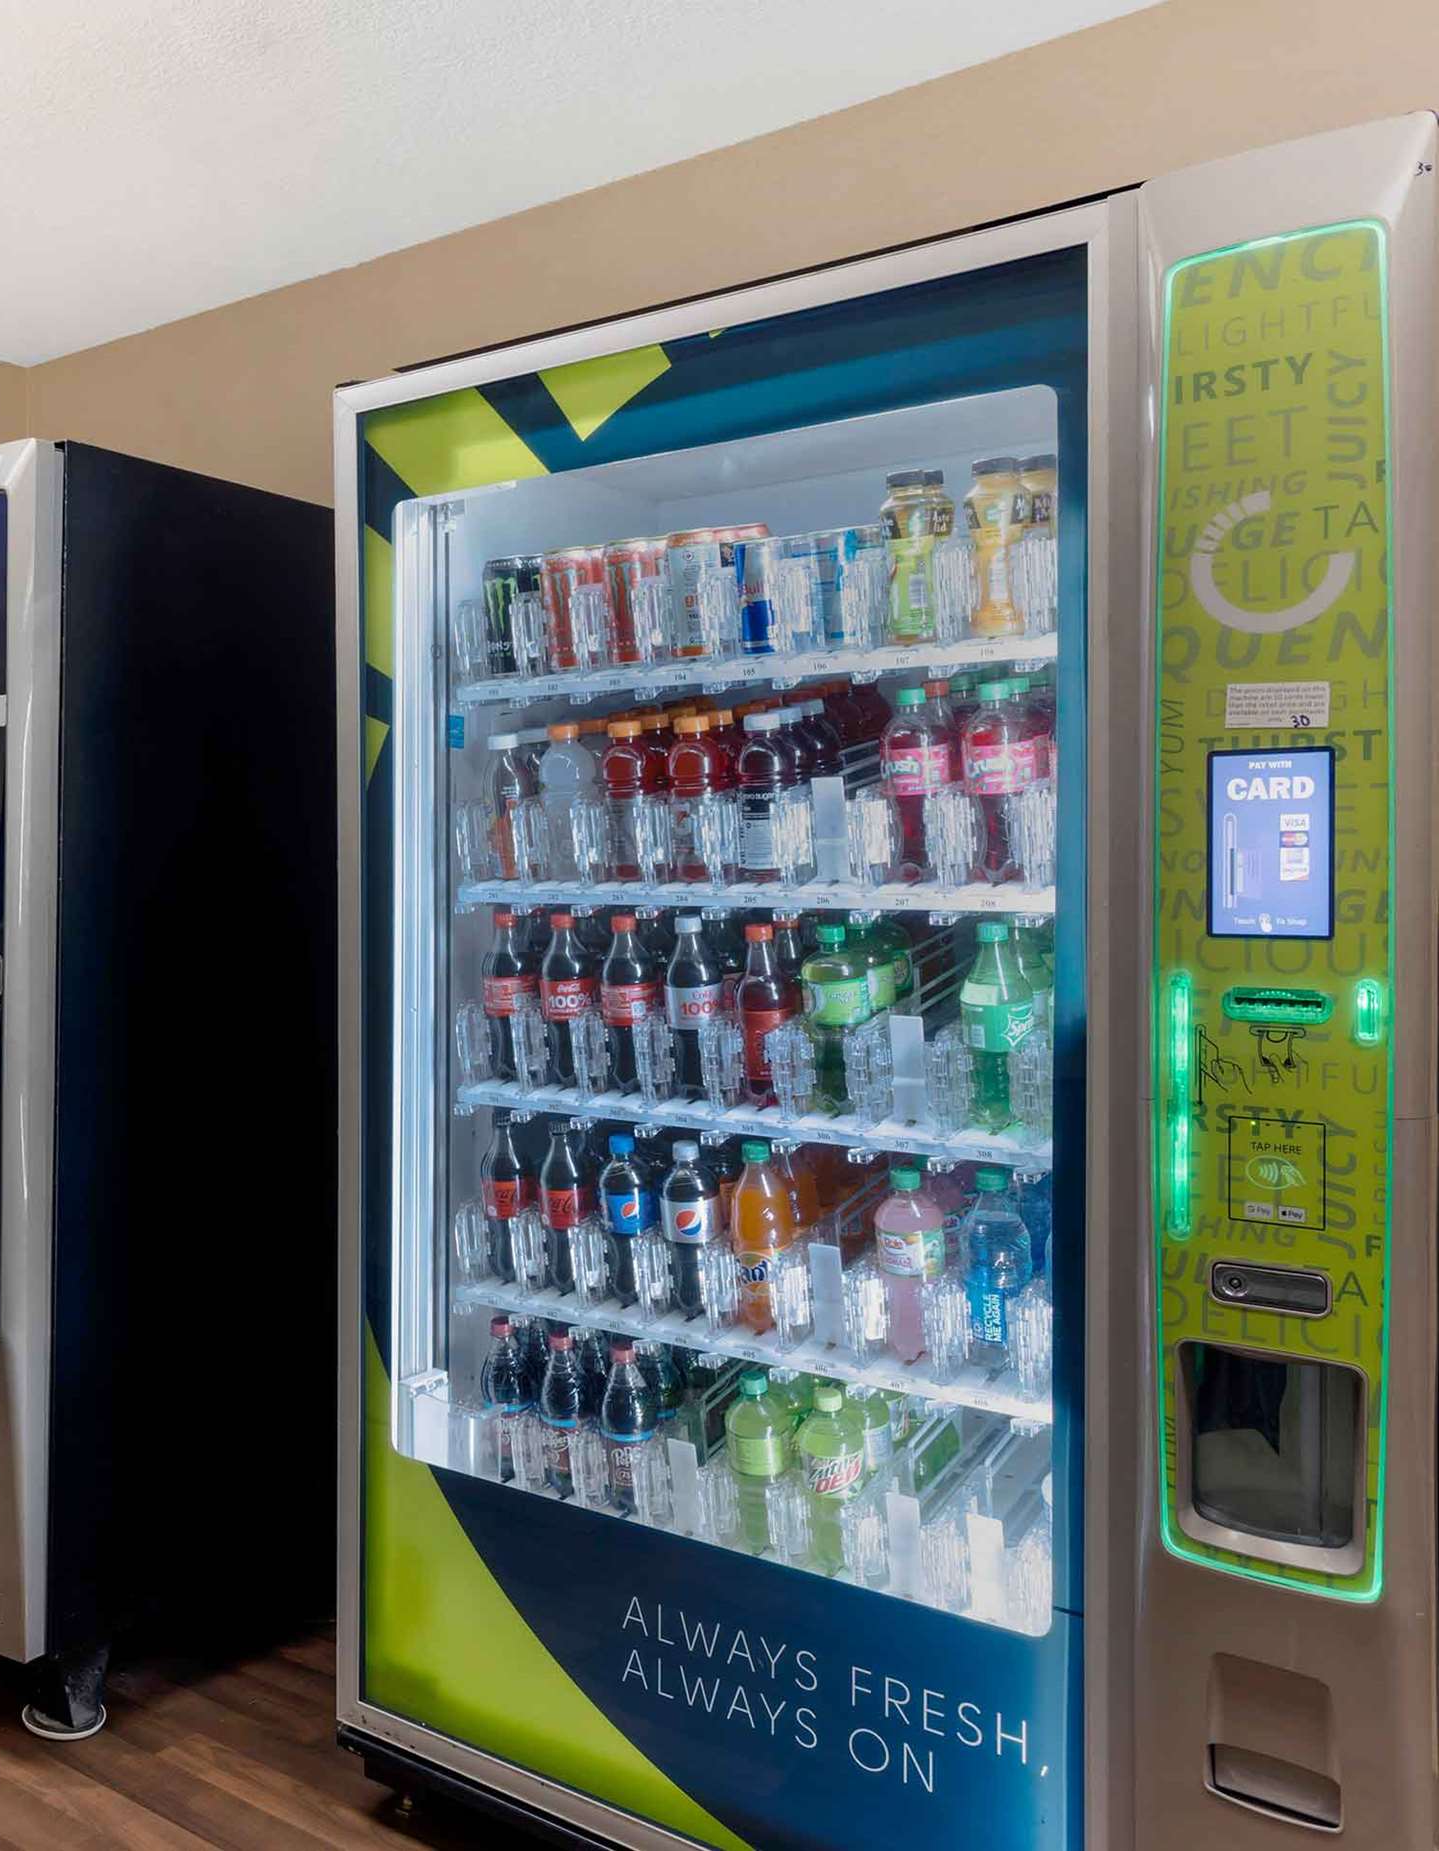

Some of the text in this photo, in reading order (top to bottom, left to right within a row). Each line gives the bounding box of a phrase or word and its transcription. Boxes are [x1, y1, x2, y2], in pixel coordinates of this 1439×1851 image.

[1290, 714, 1311, 729] 30
[1227, 776, 1315, 801] CARD
[1250, 1141, 1303, 1156] TAP HERE
[622, 1596, 1049, 1777] ALWAYS FRESH,
[622, 1649, 934, 1793] ALWAYS ON
